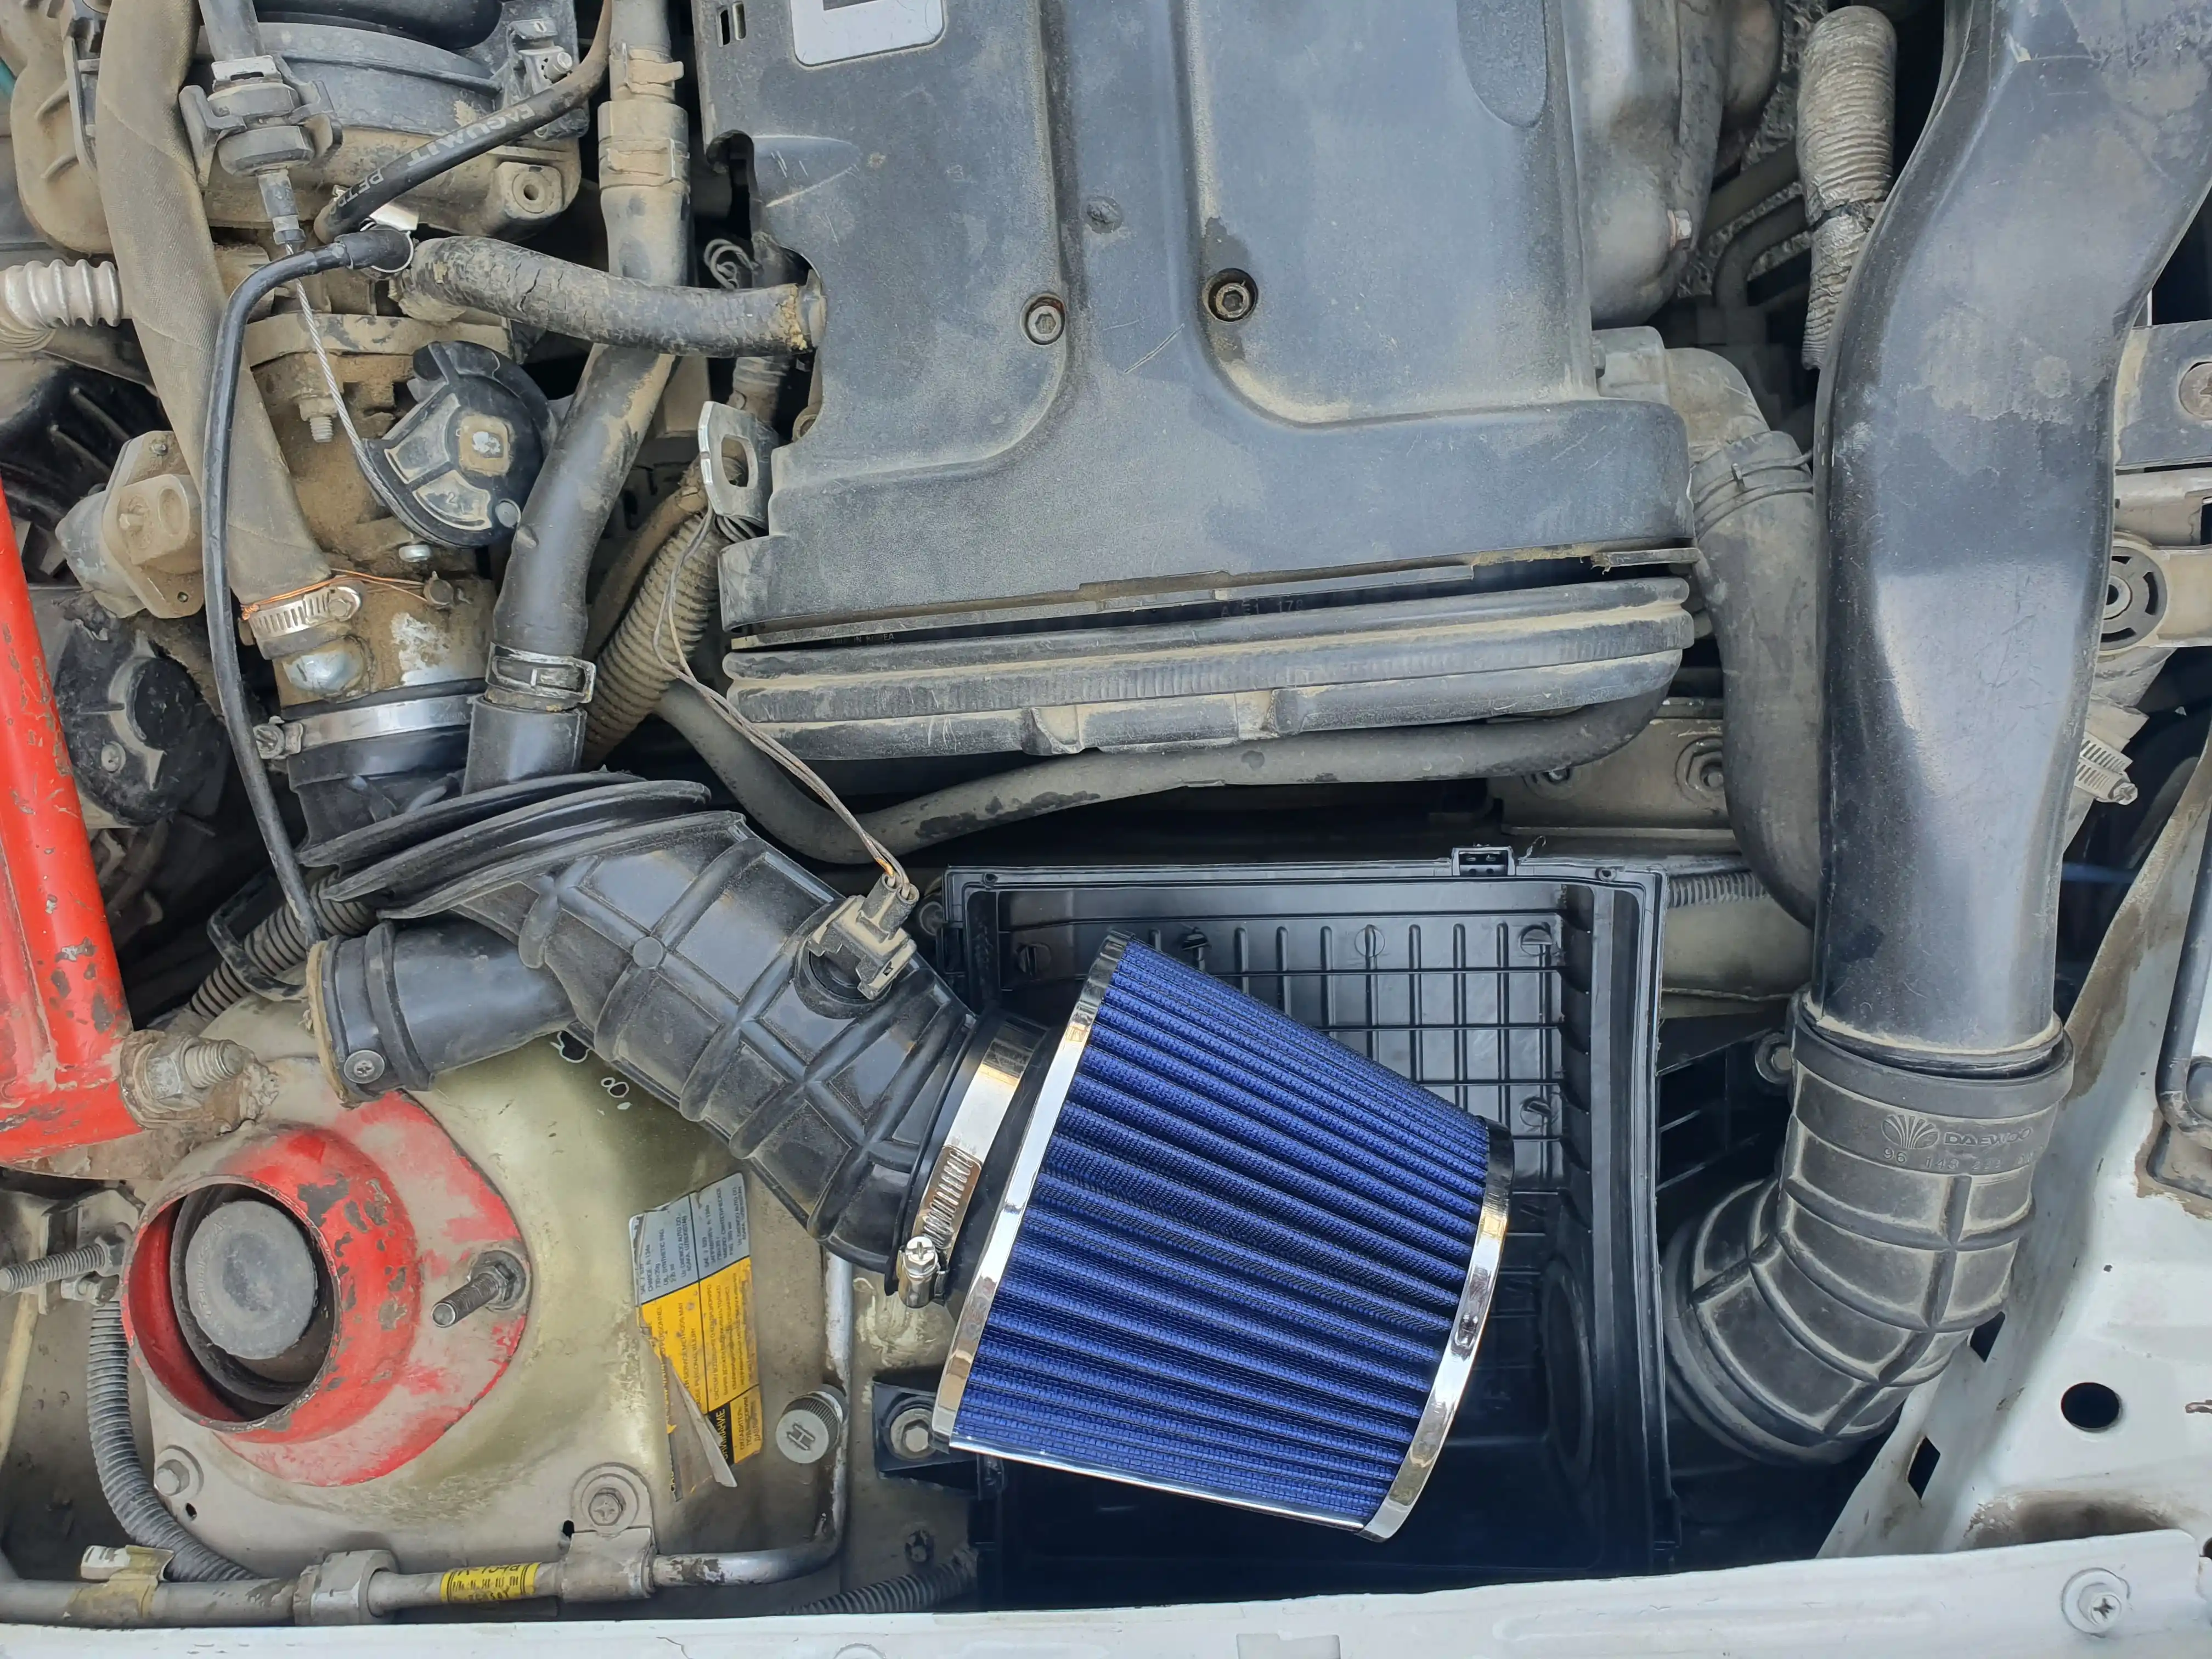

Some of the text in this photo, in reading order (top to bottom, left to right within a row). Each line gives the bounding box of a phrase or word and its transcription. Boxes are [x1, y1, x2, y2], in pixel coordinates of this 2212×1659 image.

[407, 103, 536, 167] FAGUMIT
[1944, 1126, 2033, 1146] DAEWOO
[1882, 1147, 1907, 1164] 96
